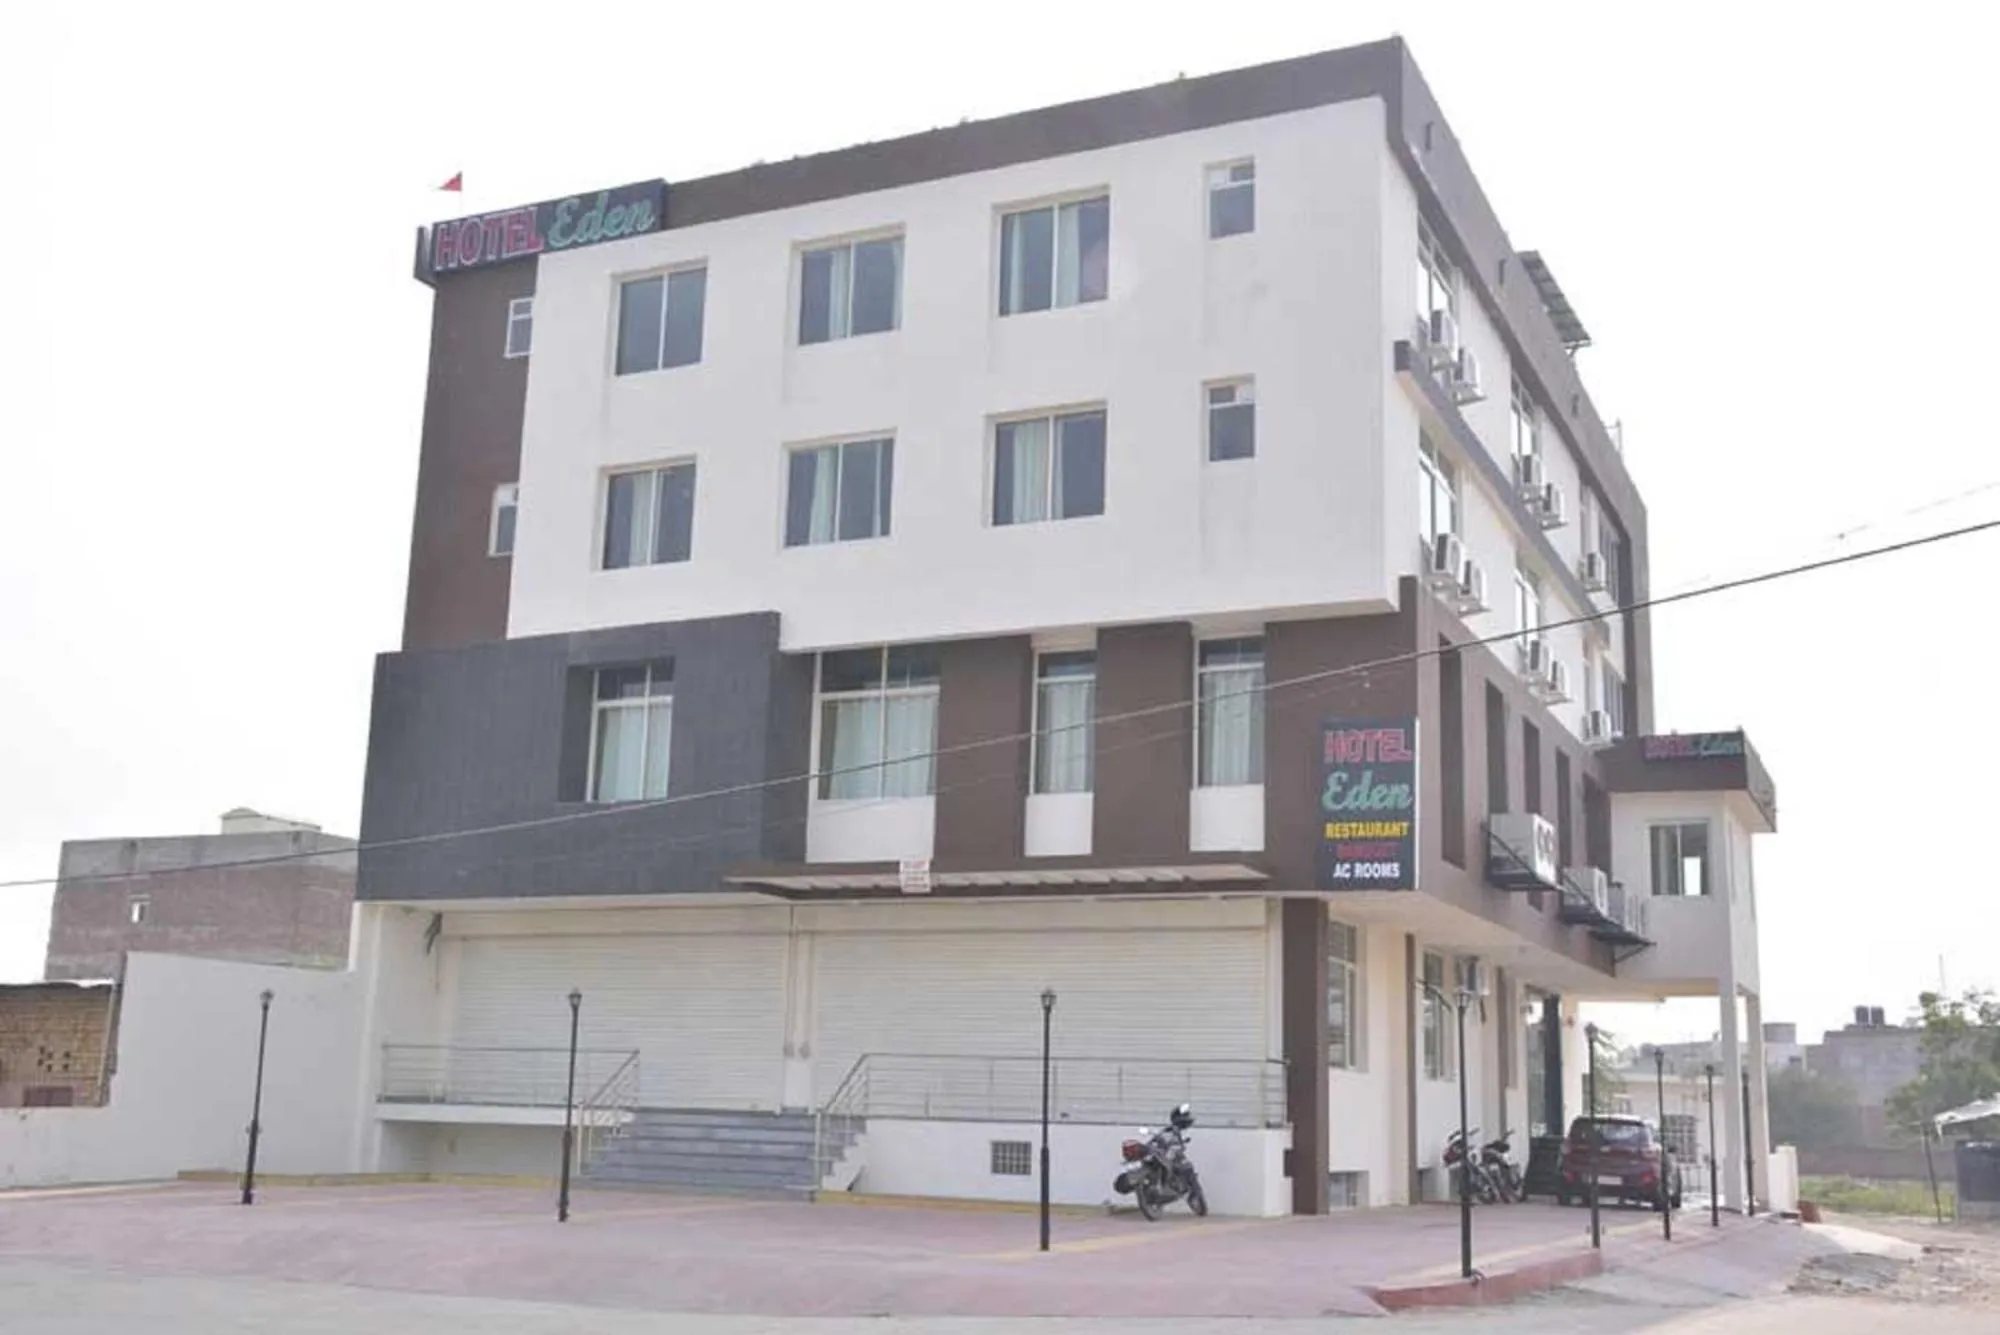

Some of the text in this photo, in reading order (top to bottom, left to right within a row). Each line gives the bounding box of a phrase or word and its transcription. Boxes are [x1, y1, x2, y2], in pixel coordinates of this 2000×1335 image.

[435, 192, 655, 270] HOTEL Eden
[1323, 728, 1412, 763] HOTEL
[1322, 769, 1411, 811] Eden
[1325, 821, 1408, 839] RESTAURANT
[1333, 861, 1400, 879] AC ROOMS
